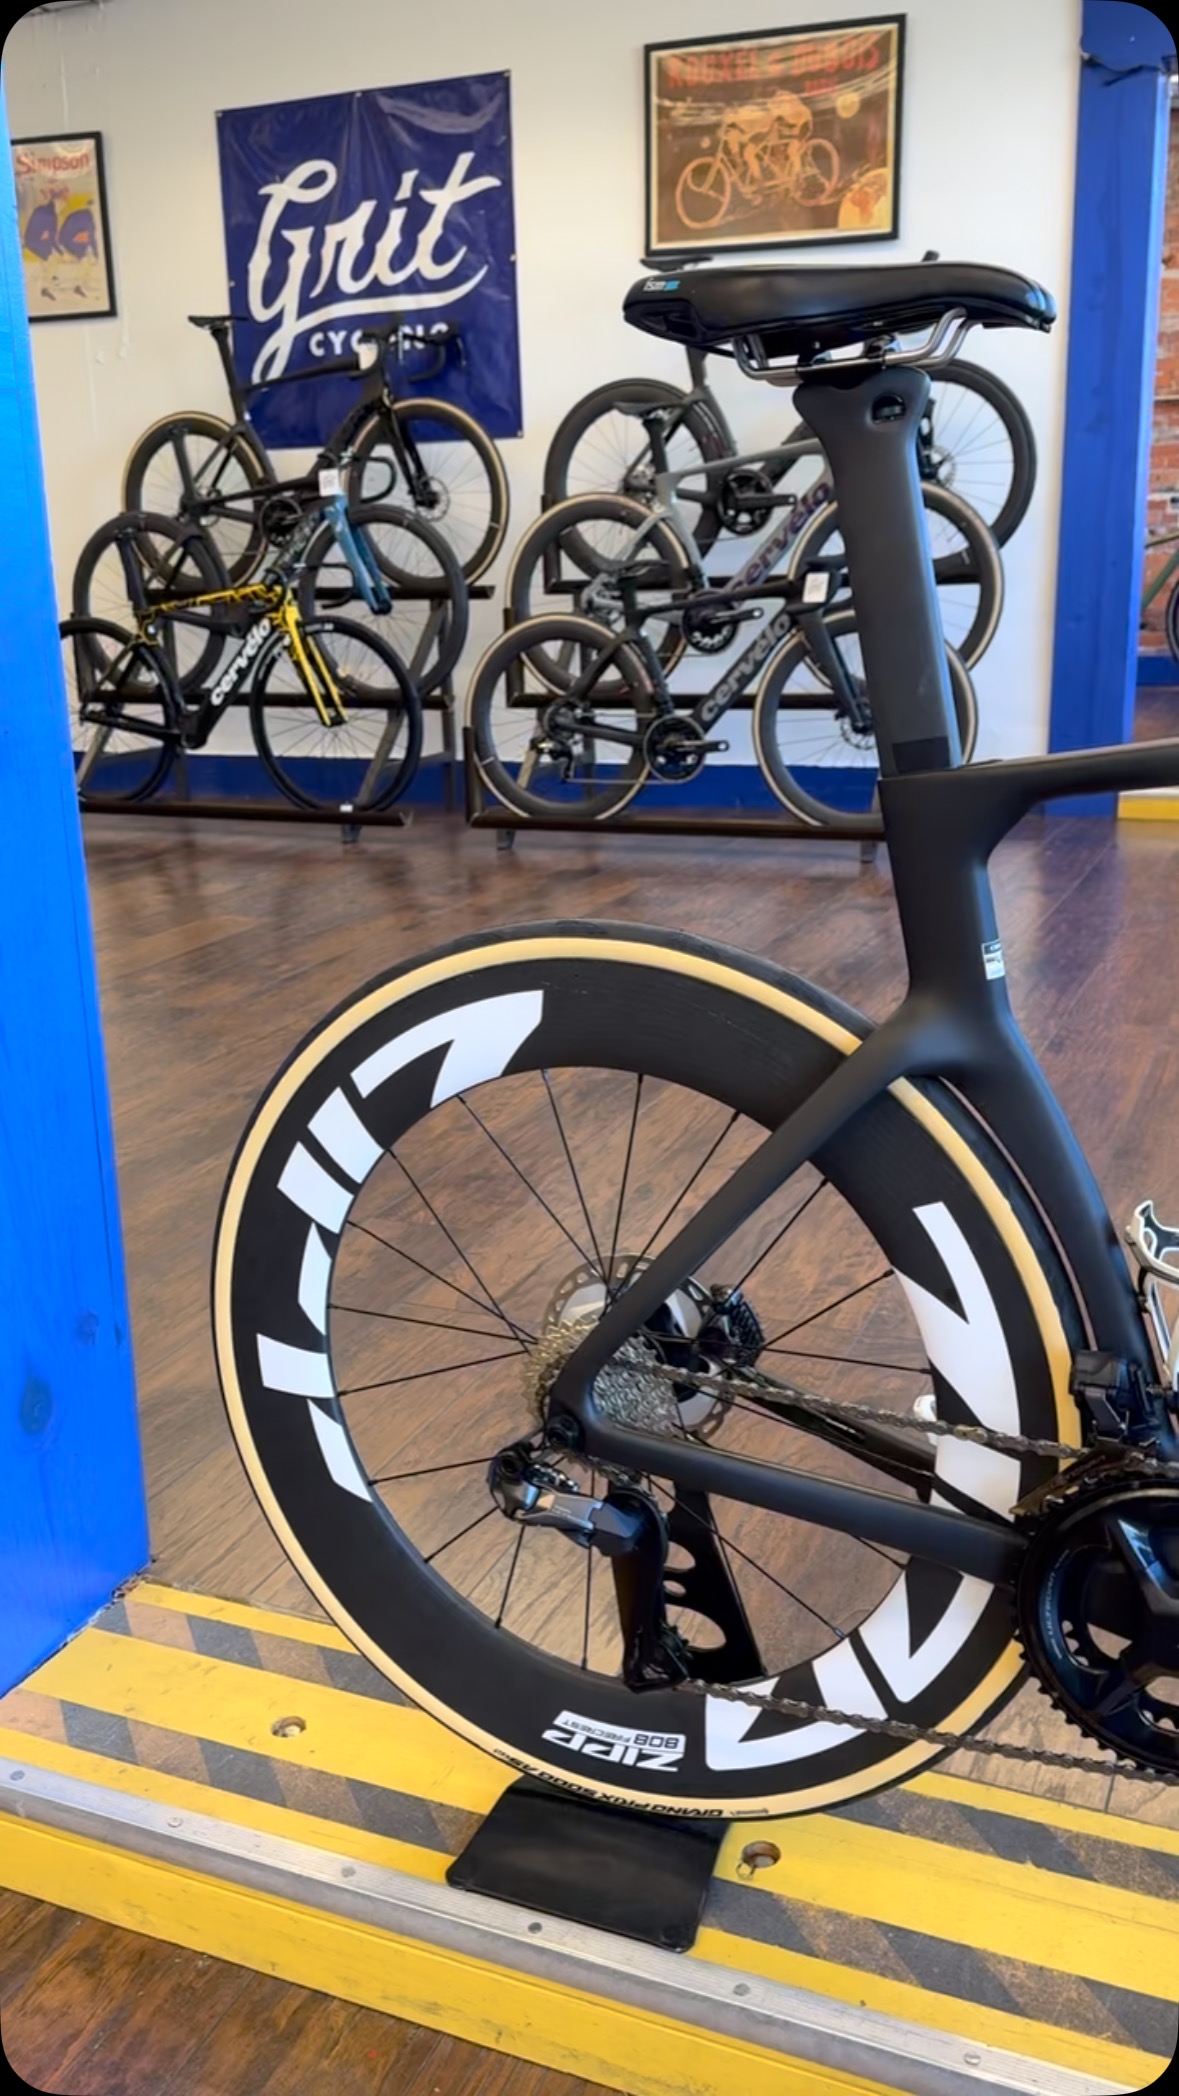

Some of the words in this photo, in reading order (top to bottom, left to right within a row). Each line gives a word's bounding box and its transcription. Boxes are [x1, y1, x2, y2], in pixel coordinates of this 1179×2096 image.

[248, 151, 502, 386] Grit
[541, 1728, 685, 1772] ZIPP
[633, 1733, 681, 1749] 808
[650, 1803, 724, 1818] GRAND
